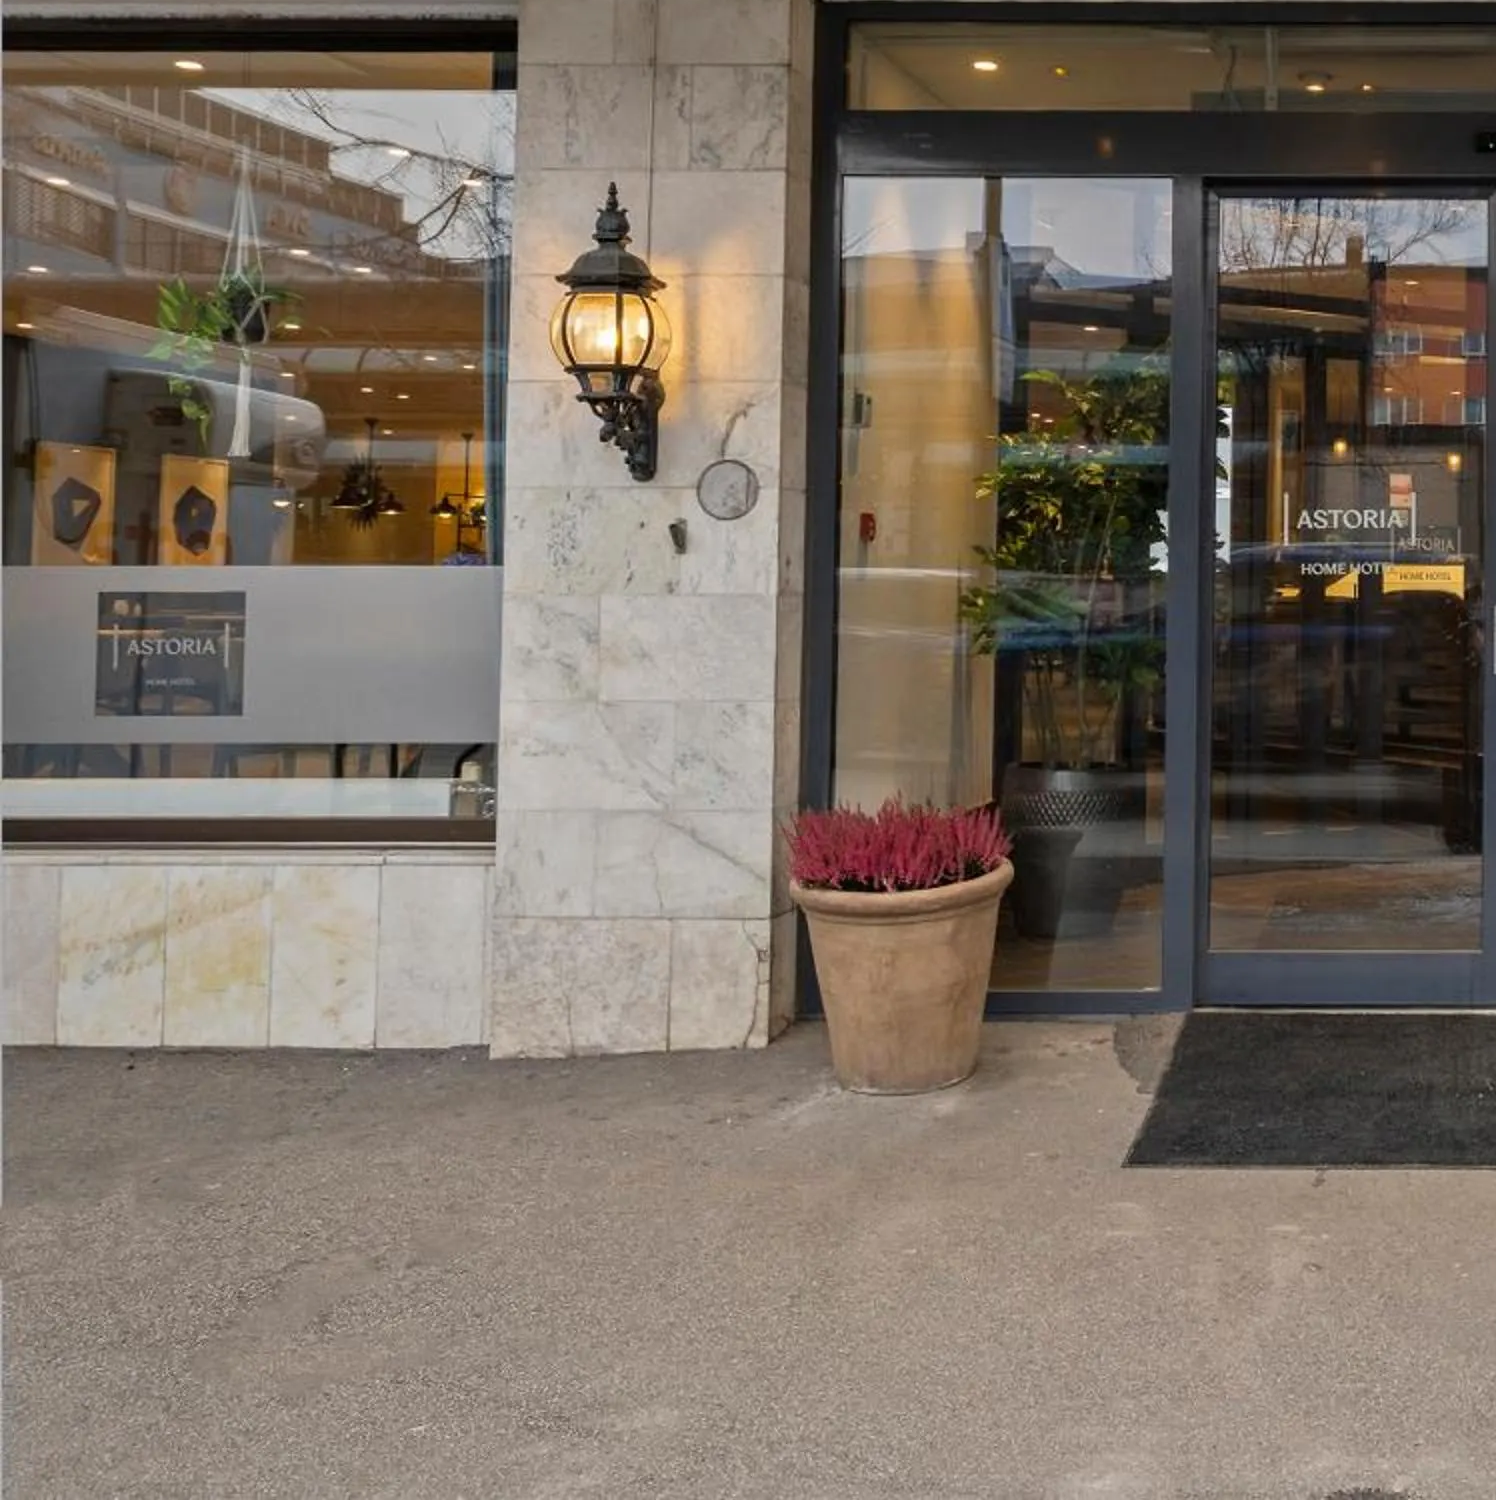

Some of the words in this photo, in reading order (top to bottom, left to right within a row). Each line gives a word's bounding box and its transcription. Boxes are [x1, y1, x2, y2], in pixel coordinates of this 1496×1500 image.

[1296, 509, 1403, 530] ASTORIA
[1397, 536, 1456, 552] ASTORIA
[1301, 562, 1346, 575] HOME
[1399, 571, 1424, 581] HOME
[1425, 571, 1452, 581] HOTEL
[127, 637, 217, 656] ASTORIA
